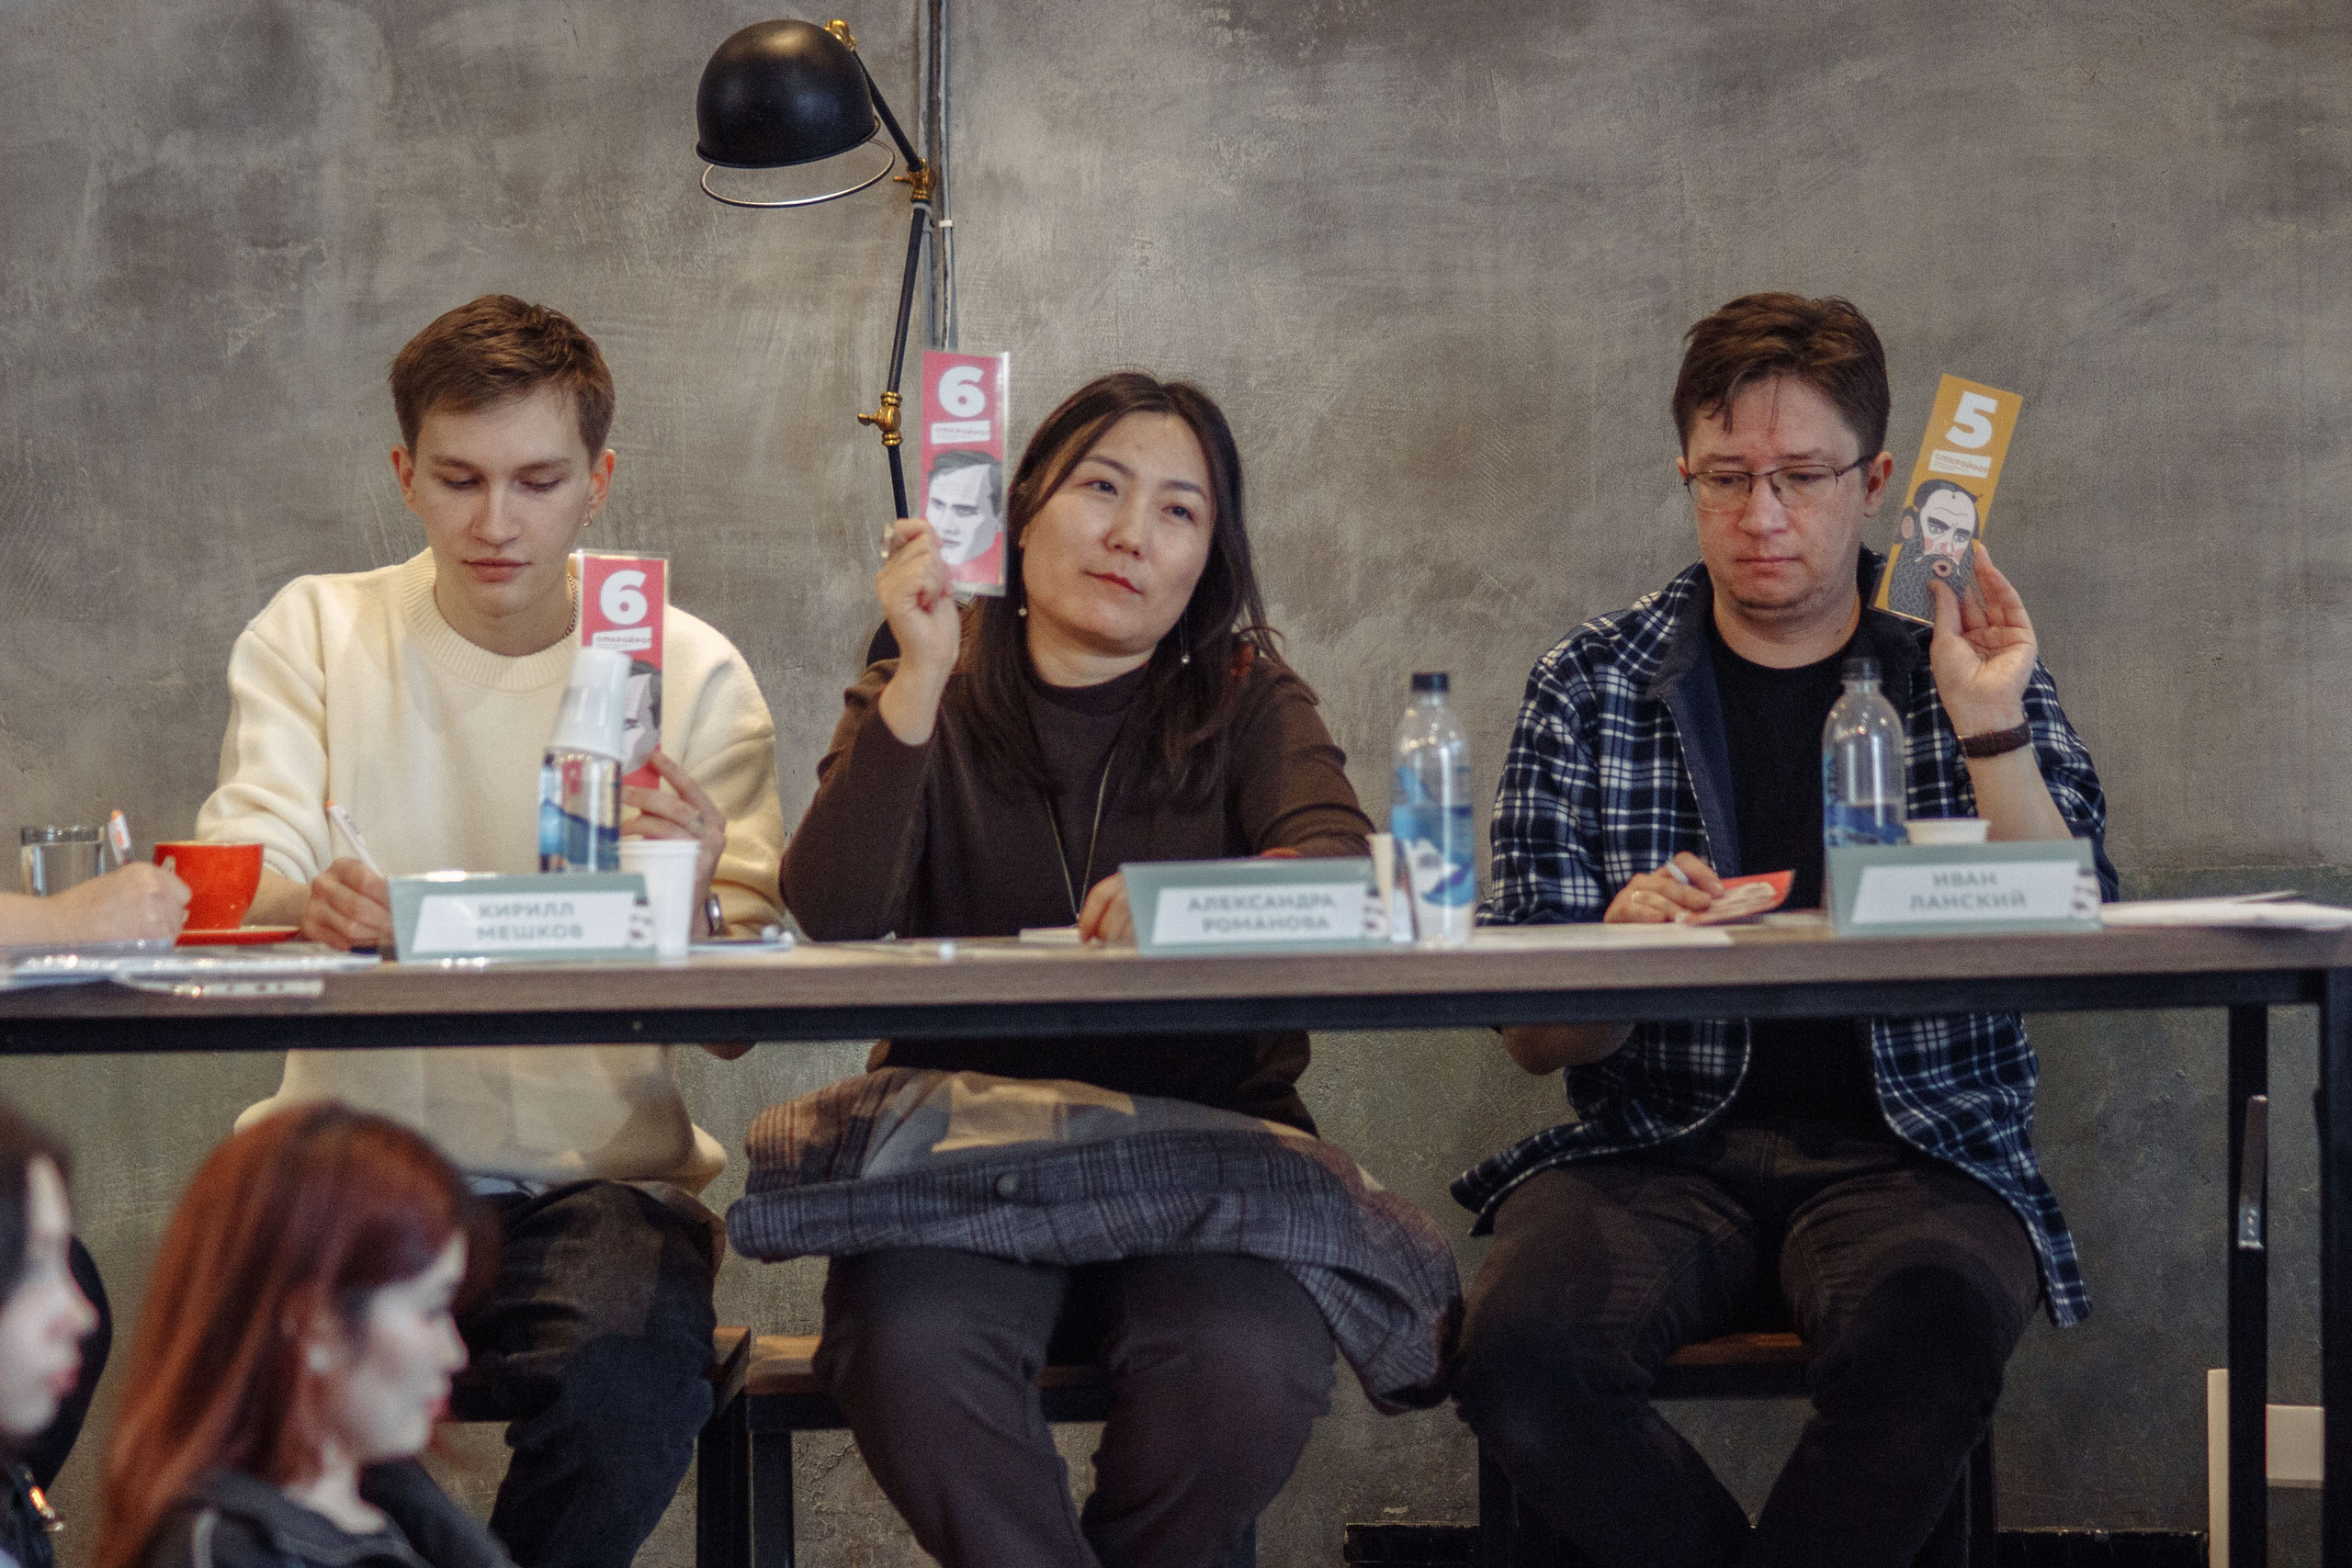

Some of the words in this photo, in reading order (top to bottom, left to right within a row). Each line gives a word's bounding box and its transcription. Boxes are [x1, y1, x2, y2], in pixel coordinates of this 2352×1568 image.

[938, 366, 986, 417] 6
[1945, 390, 1998, 448] 5
[600, 570, 648, 625] 6
[1932, 871, 1997, 887] ИВАН
[478, 901, 575, 918] КИРИЛЛ
[1188, 892, 1335, 911] АЛЕКСАНДРА
[476, 923, 583, 940] МЕШКОВ
[1202, 916, 1330, 932] РОМАНОВА
